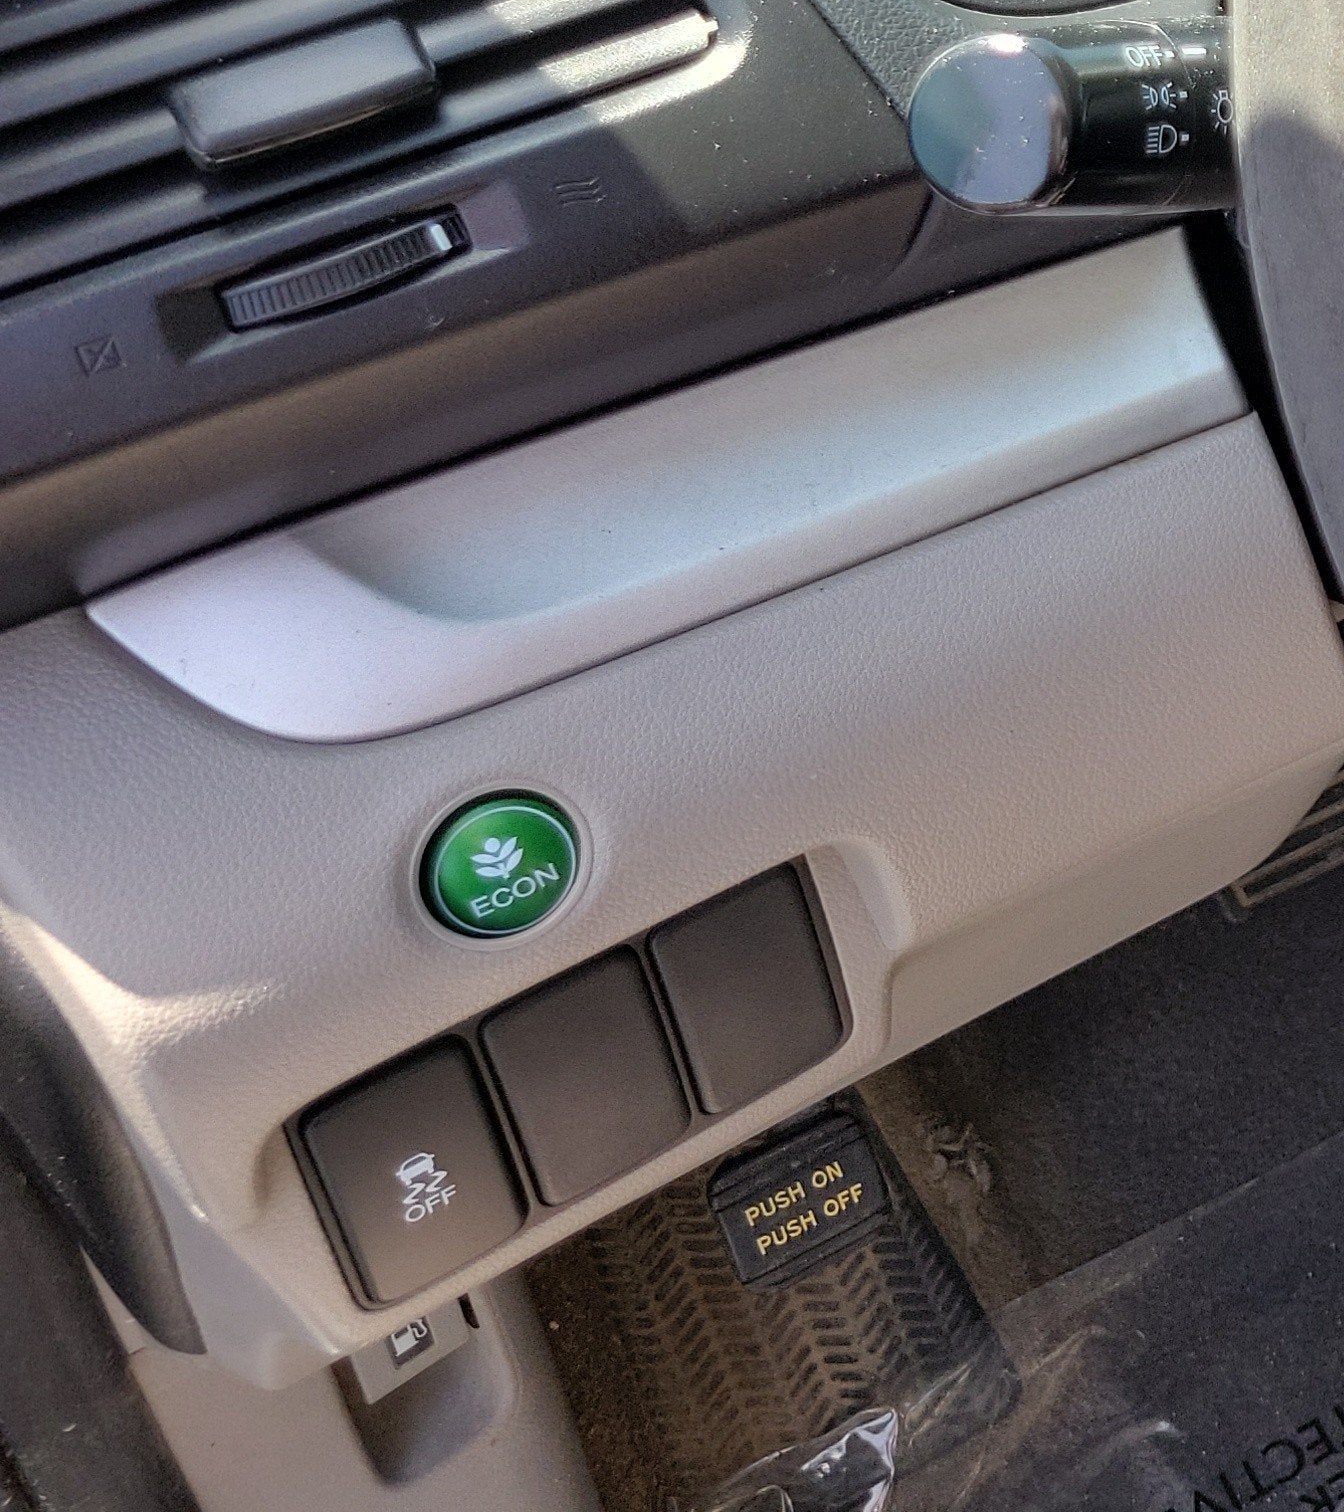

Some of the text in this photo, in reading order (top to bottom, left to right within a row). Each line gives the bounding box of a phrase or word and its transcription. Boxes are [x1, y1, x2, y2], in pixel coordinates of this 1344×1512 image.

[1125, 44, 1163, 69] OFF
[470, 862, 560, 918] ECON
[404, 1182, 457, 1224] OFF
[744, 1160, 844, 1228] PUSH ON
[756, 1182, 865, 1257] PUSH OFF
